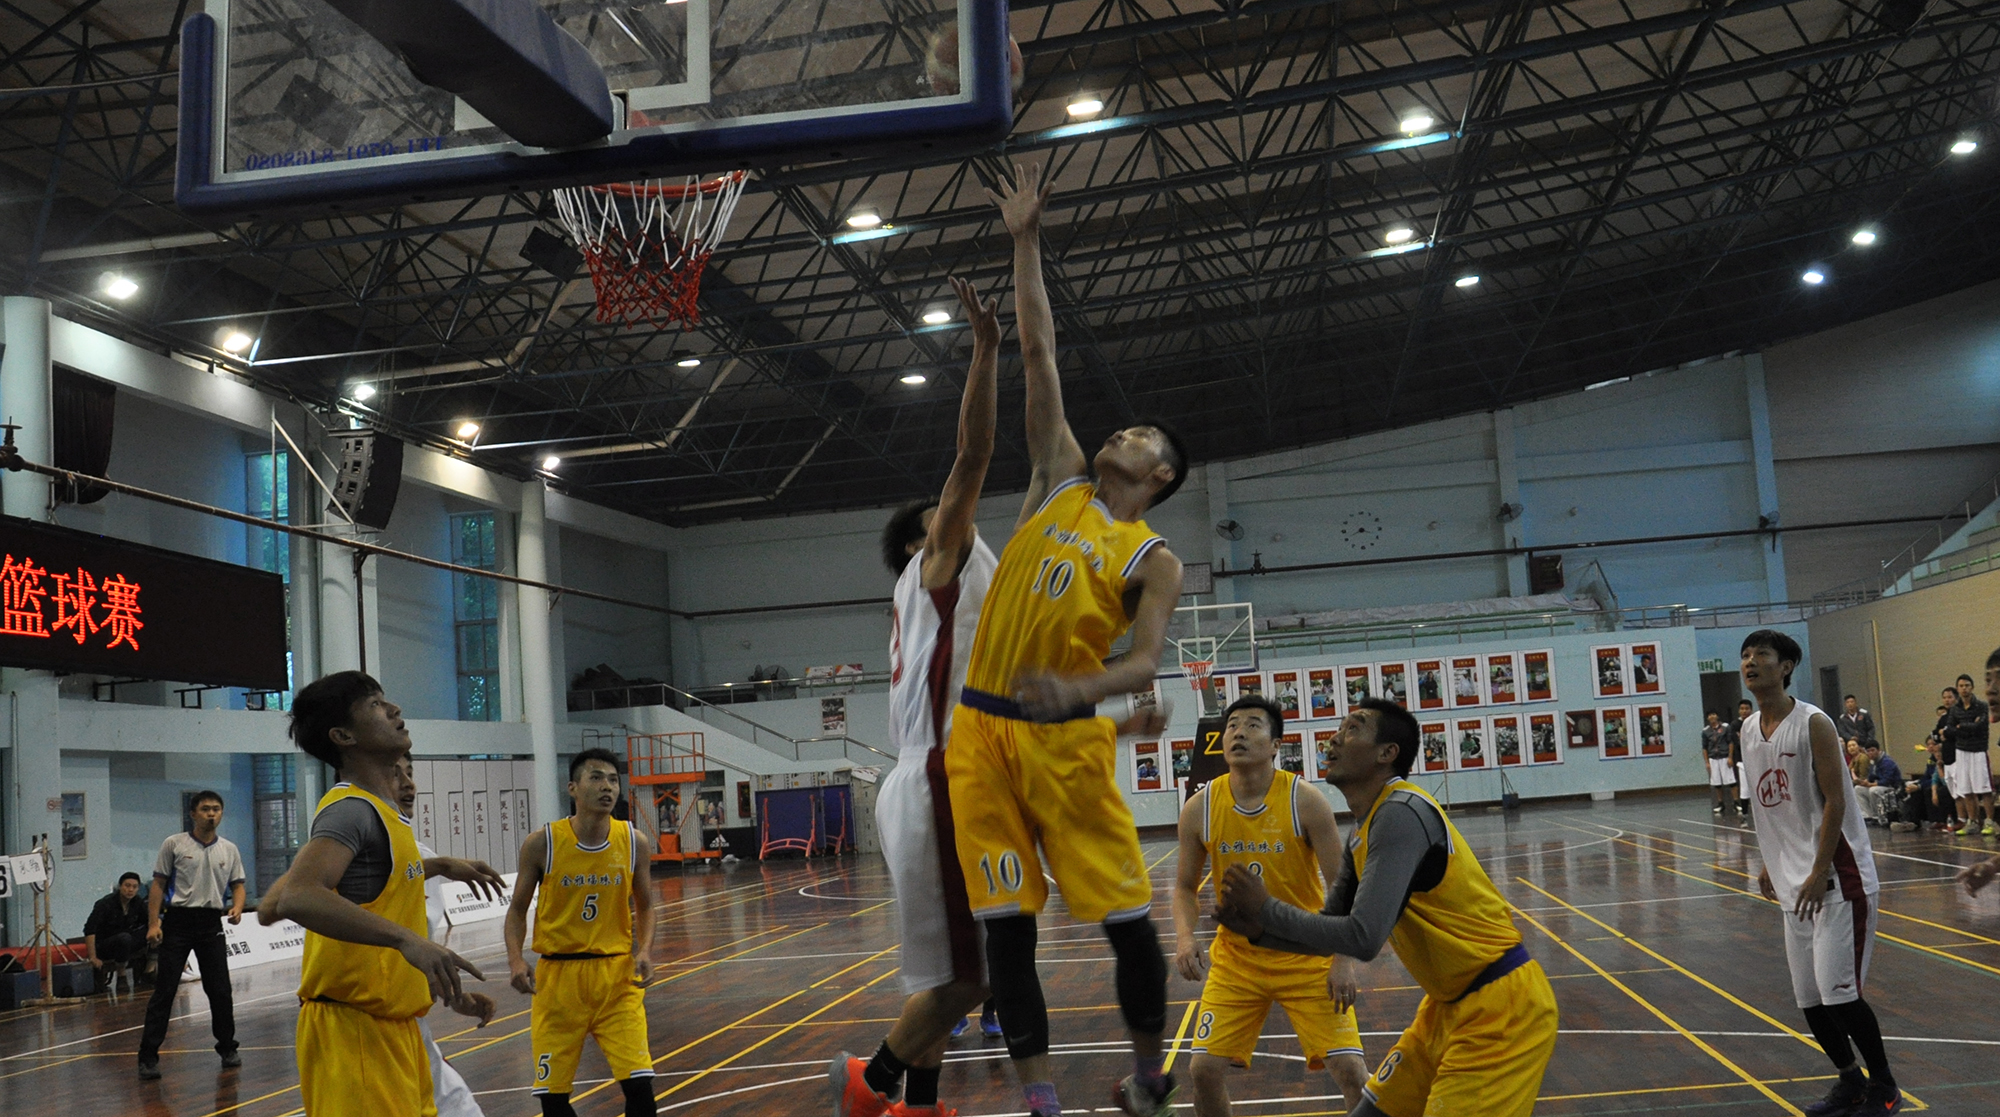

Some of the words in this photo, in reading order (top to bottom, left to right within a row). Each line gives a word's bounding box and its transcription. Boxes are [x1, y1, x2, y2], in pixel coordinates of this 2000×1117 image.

[1031, 555, 1075, 600] 10
[0, 553, 144, 651] 篮球赛
[979, 850, 1023, 897] 10
[581, 892, 599, 922] 5
[1197, 1011, 1215, 1040] 8
[537, 1052, 552, 1082] 5
[1377, 1051, 1402, 1082] 6
